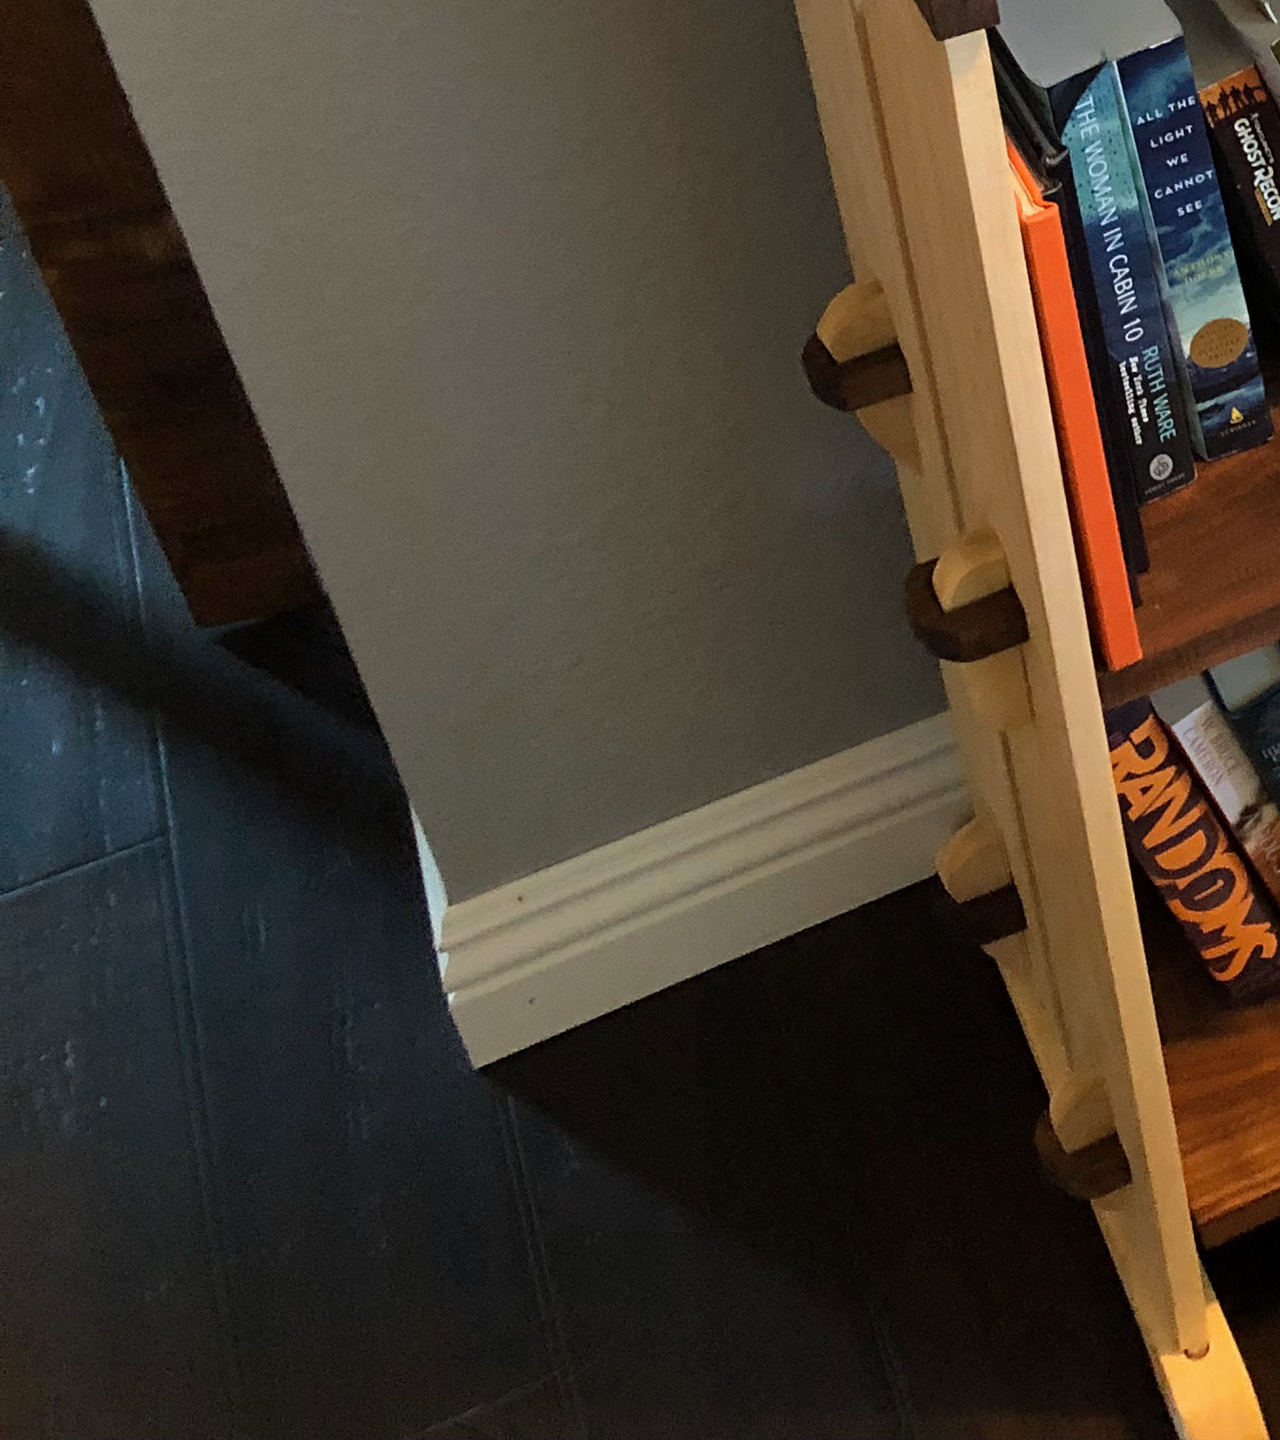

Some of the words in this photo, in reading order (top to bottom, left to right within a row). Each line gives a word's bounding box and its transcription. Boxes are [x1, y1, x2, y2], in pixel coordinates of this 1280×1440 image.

[1075, 94, 1099, 141] THE
[1136, 108, 1163, 126] ALL
[1167, 95, 1197, 113] THE
[1149, 124, 1194, 149] LIGHT
[1233, 117, 1264, 172] GHOST
[1165, 152, 1189, 169] WE
[1084, 147, 1119, 227] WOMAN
[1153, 169, 1215, 200] CANNOT
[1176, 199, 1203, 217] SEE
[1102, 225, 1124, 253] IN
[1108, 254, 1138, 316] CABIN
[1122, 317, 1144, 343] 10
[1141, 344, 1166, 392] RUTH
[1132, 372, 1144, 397] York
[1130, 416, 1144, 446] author
[1152, 392, 1178, 444] WARE
